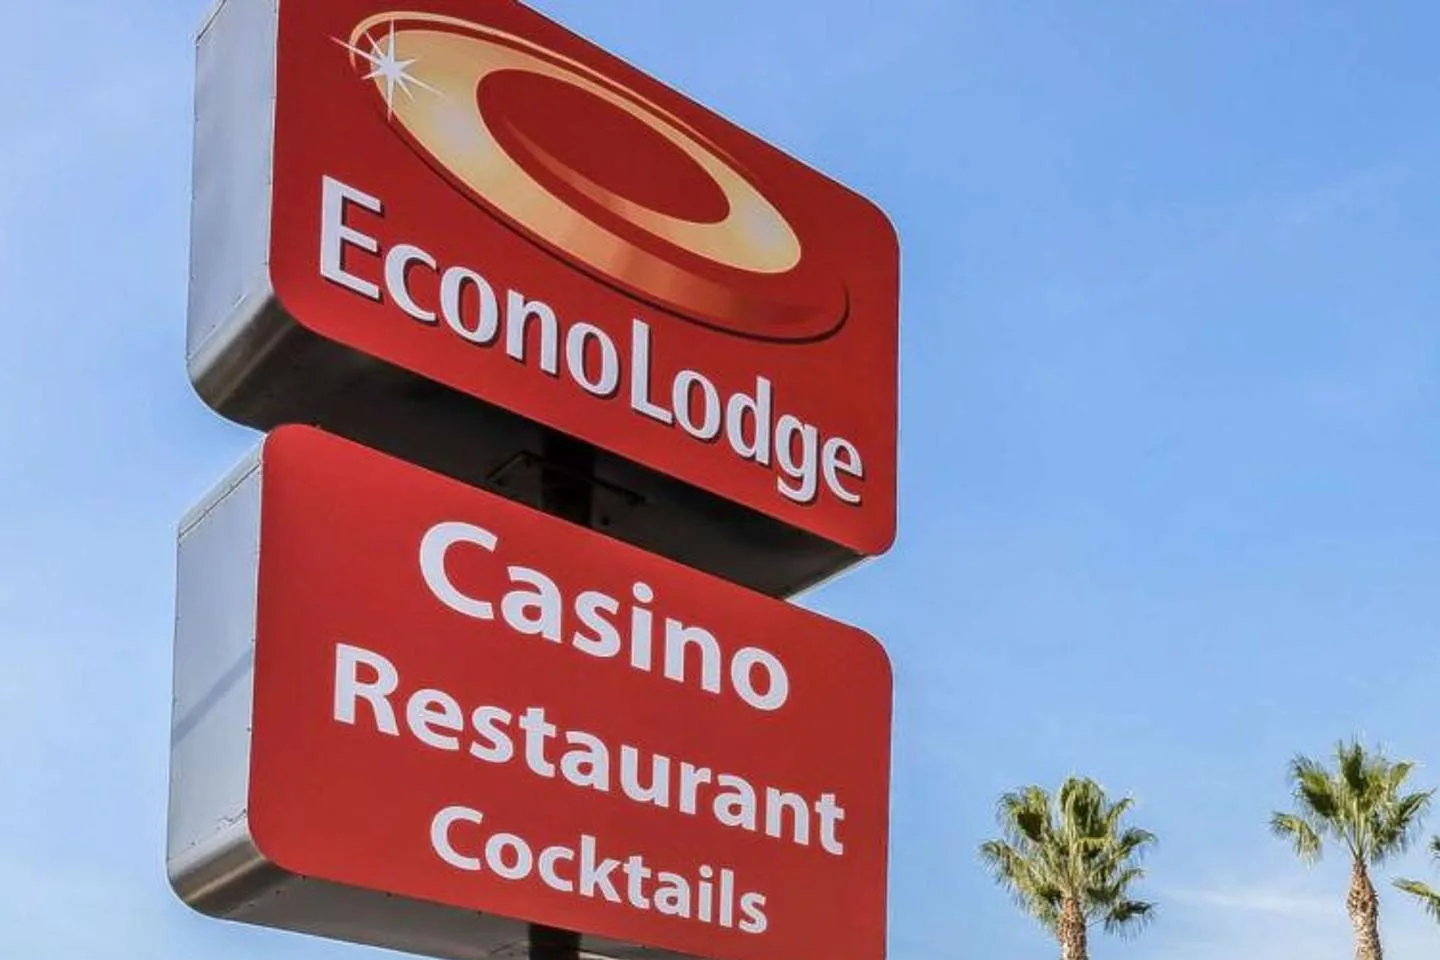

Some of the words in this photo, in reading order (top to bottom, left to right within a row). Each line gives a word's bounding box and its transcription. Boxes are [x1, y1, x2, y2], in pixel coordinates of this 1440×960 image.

[319, 174, 864, 504] EconoLodge
[419, 521, 789, 712] Casino
[333, 642, 846, 856] Restaurant
[430, 805, 769, 935] Cocktails
